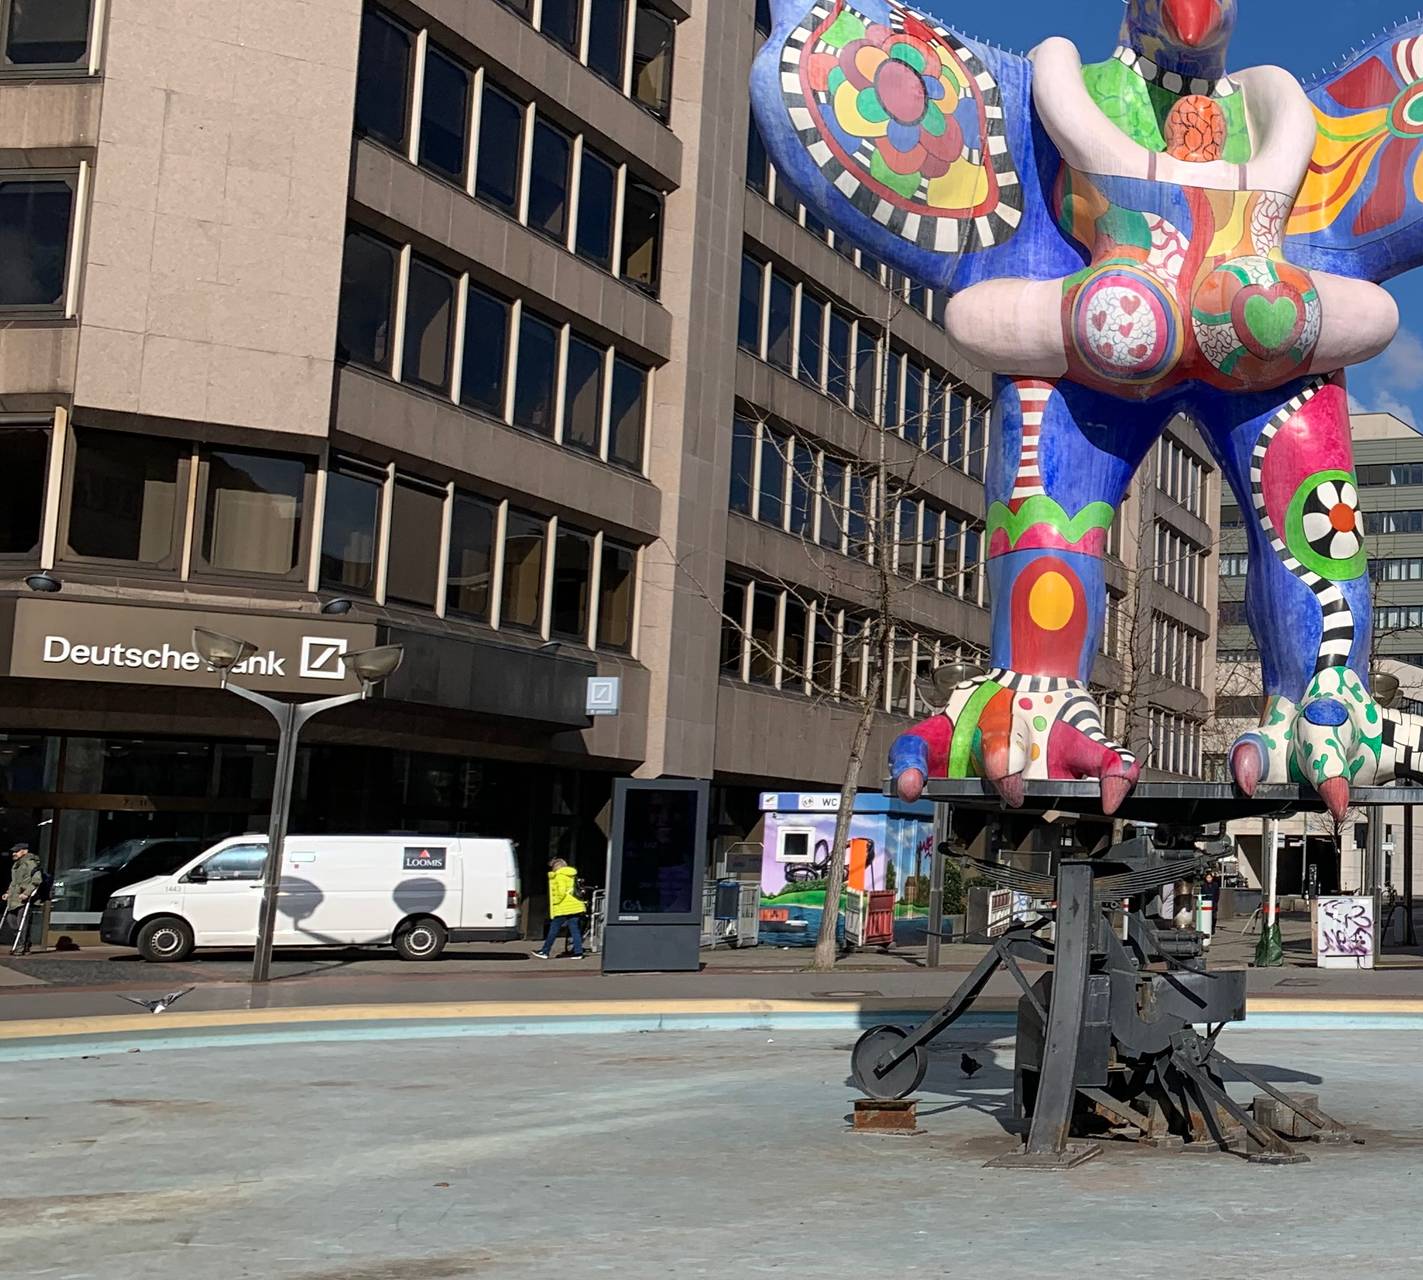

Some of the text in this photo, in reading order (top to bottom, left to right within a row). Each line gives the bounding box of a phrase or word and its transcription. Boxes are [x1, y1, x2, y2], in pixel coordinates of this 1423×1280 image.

[43, 635, 286, 676] Deutsche ank
[822, 798, 840, 808] WC
[406, 858, 443, 867] LOOMIS
